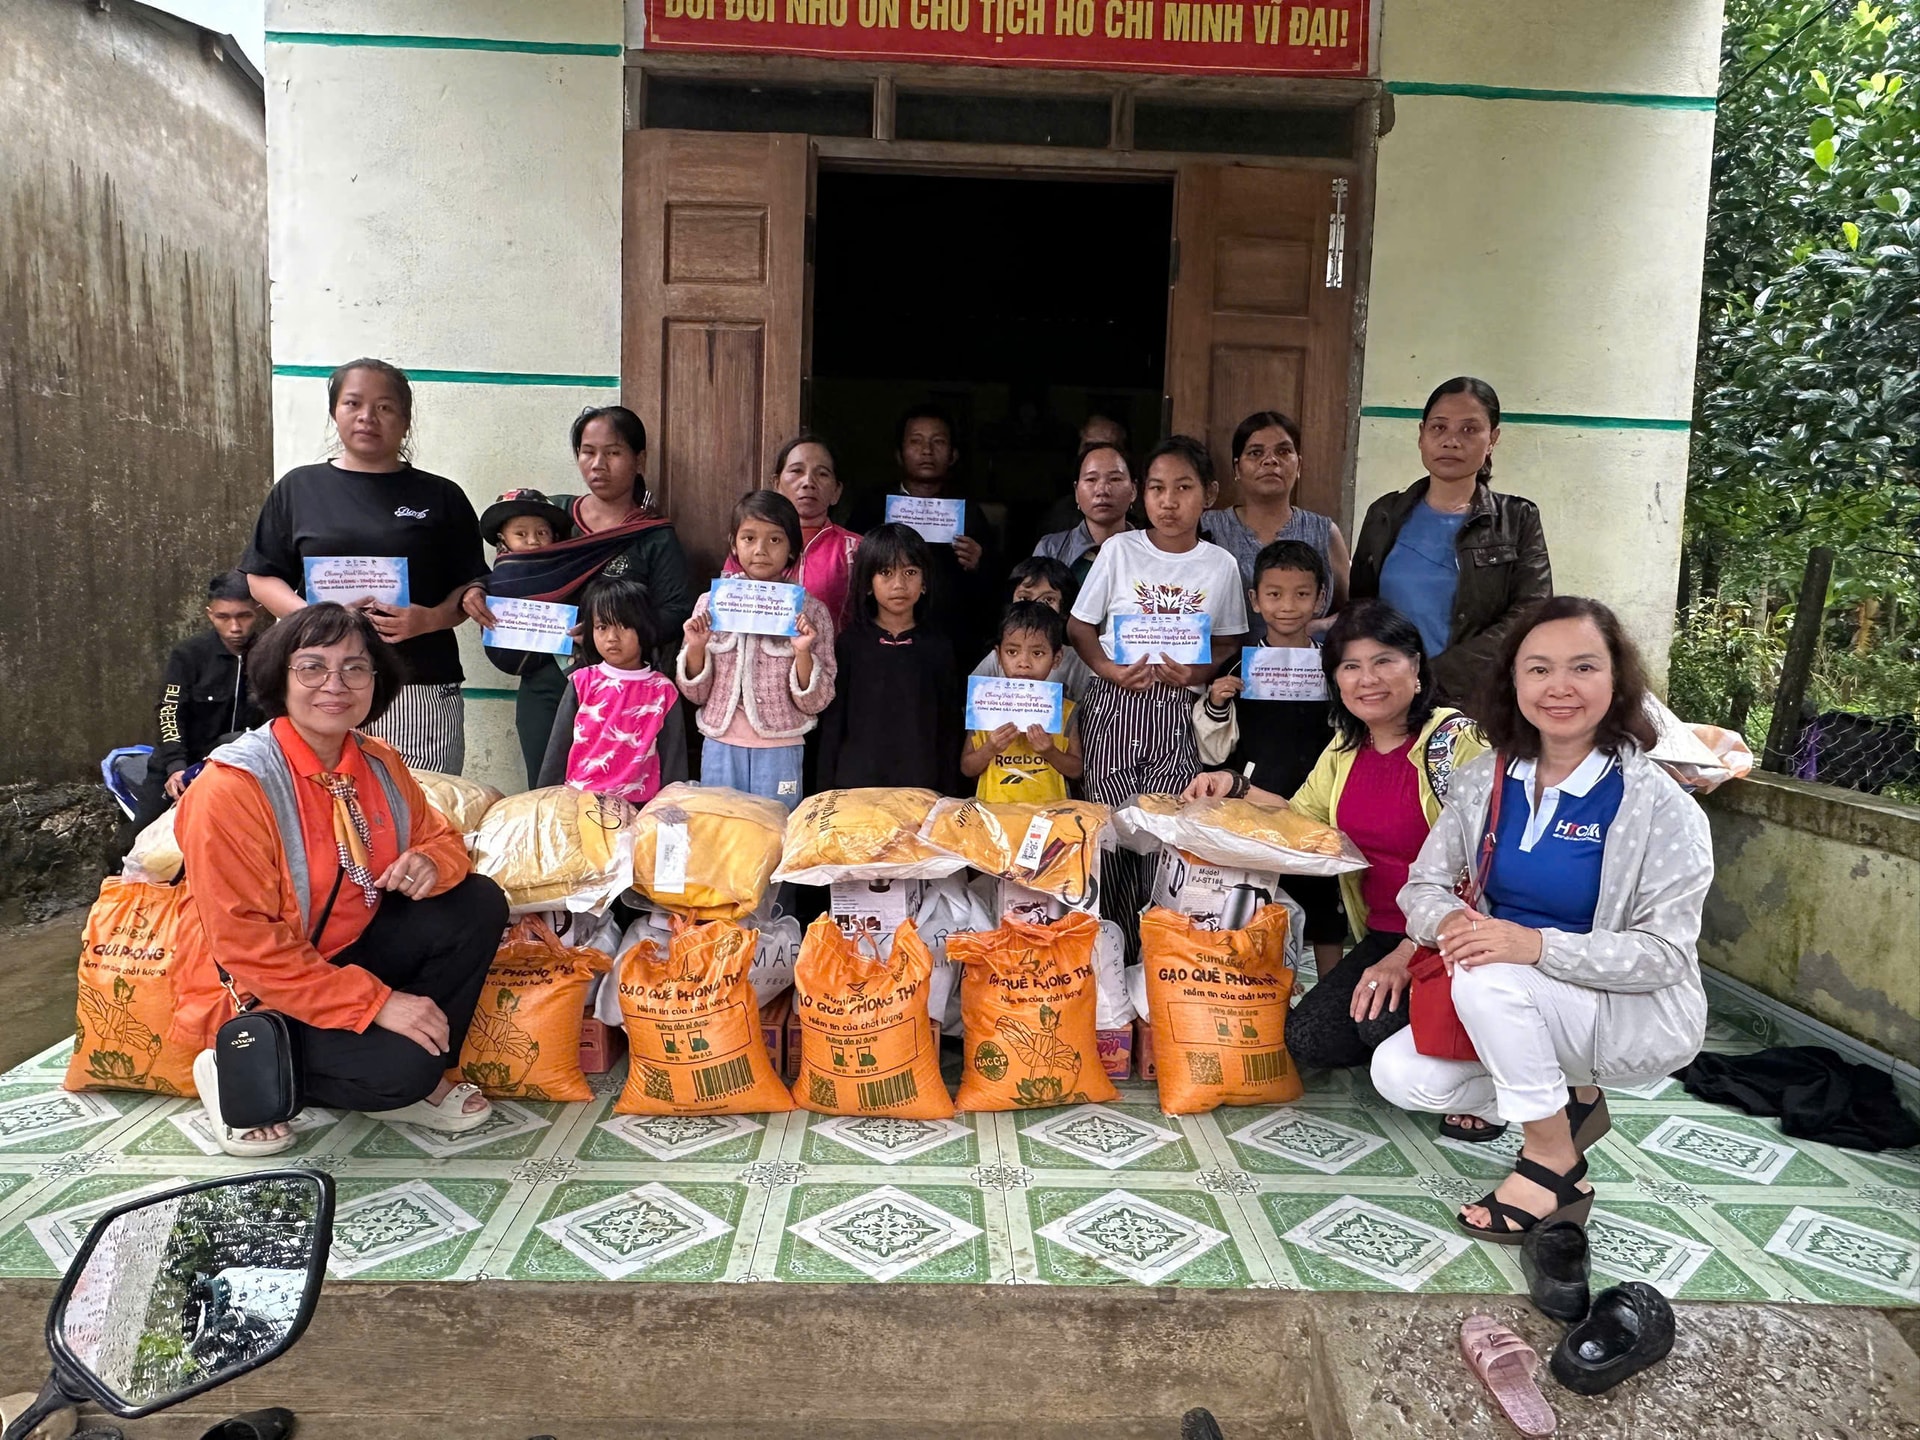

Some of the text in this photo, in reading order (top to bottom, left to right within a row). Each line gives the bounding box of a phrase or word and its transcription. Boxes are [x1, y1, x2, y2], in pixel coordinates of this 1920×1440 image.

[980, 0, 1045, 43] TỊCH
[1163, 2, 1244, 43] MINH
[1253, 0, 1282, 45] VĨ
[1288, 6, 1349, 55] ĐẠI!
[160, 684, 181, 743] BURBERRY
[995, 754, 1048, 767] Reebo
[1199, 868, 1220, 876] Model
[1158, 968, 1188, 984] GẠO
[1191, 967, 1221, 984] QUÊ
[975, 1056, 1007, 1068] HACCP
